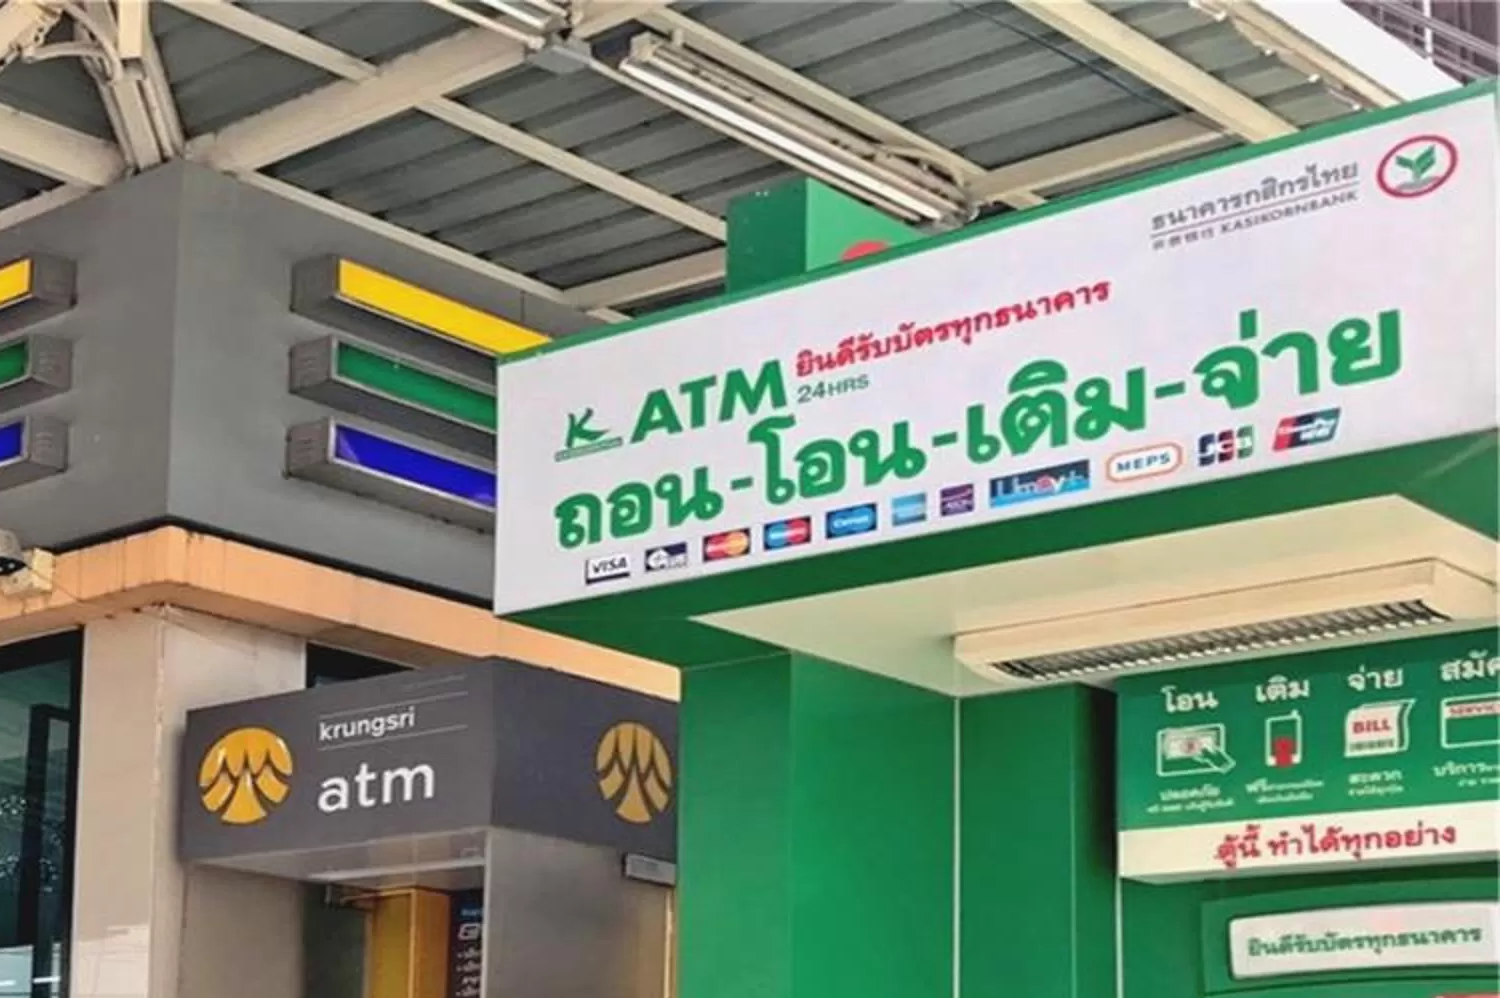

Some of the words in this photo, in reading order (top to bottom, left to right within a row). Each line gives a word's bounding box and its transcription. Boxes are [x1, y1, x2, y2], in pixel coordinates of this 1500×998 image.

[1221, 191, 1359, 234] KASIKORNBANK
[794, 280, 1111, 377] ยินดีรับบัตรทุกธนาคาร
[630, 360, 787, 444] ATM
[796, 374, 870, 405] 24HRS
[1115, 453, 1171, 474] MEPS
[591, 556, 628, 574] VISA
[1256, 674, 1310, 703] เติม
[1347, 666, 1404, 692] จ่าย
[1162, 685, 1219, 713] โอน
[319, 705, 415, 741] krungsri
[1352, 719, 1392, 734] BILL
[318, 762, 435, 813] atm
[1267, 819, 1457, 861] ทำได้ทุกอย่าง
